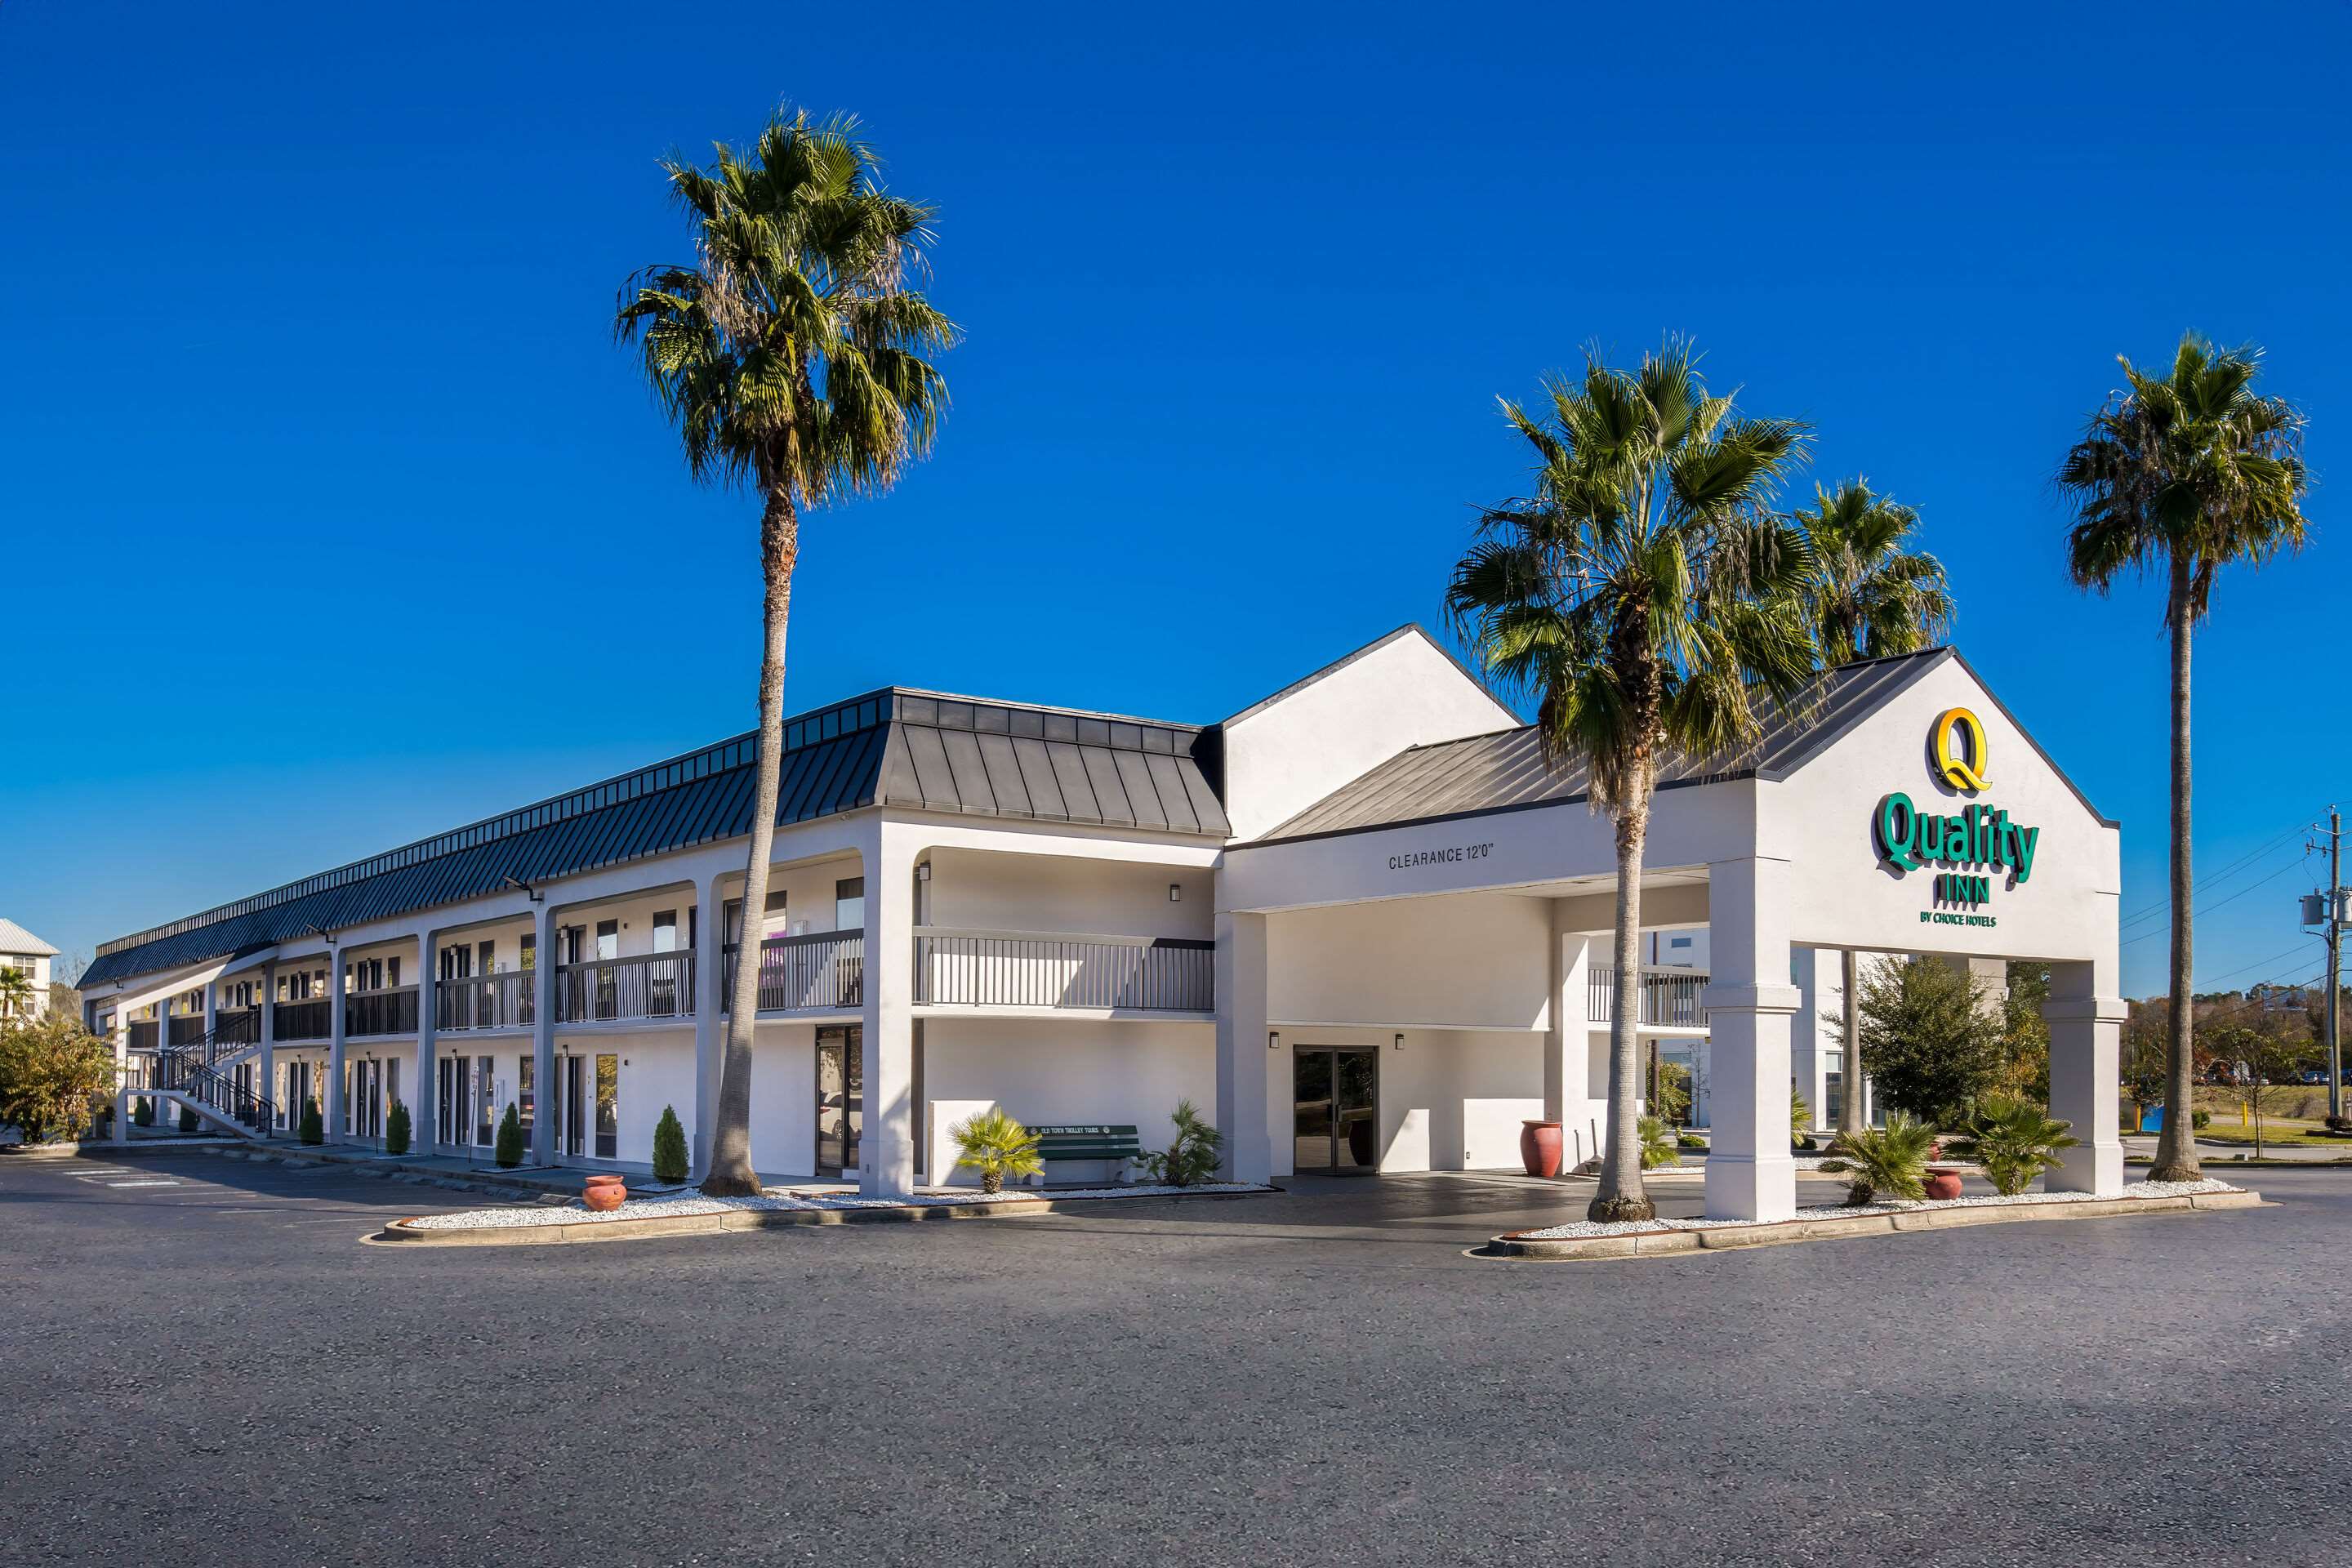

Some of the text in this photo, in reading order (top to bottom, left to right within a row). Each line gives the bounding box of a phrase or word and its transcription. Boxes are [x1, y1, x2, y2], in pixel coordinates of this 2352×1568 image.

[1931, 707, 1993, 791] Q
[1876, 792, 2039, 883] Quality
[1389, 849, 1463, 870] CLEARANCE
[1939, 873, 1989, 903] INN
[1920, 911, 1997, 928] BY CHOICE HOTELS
